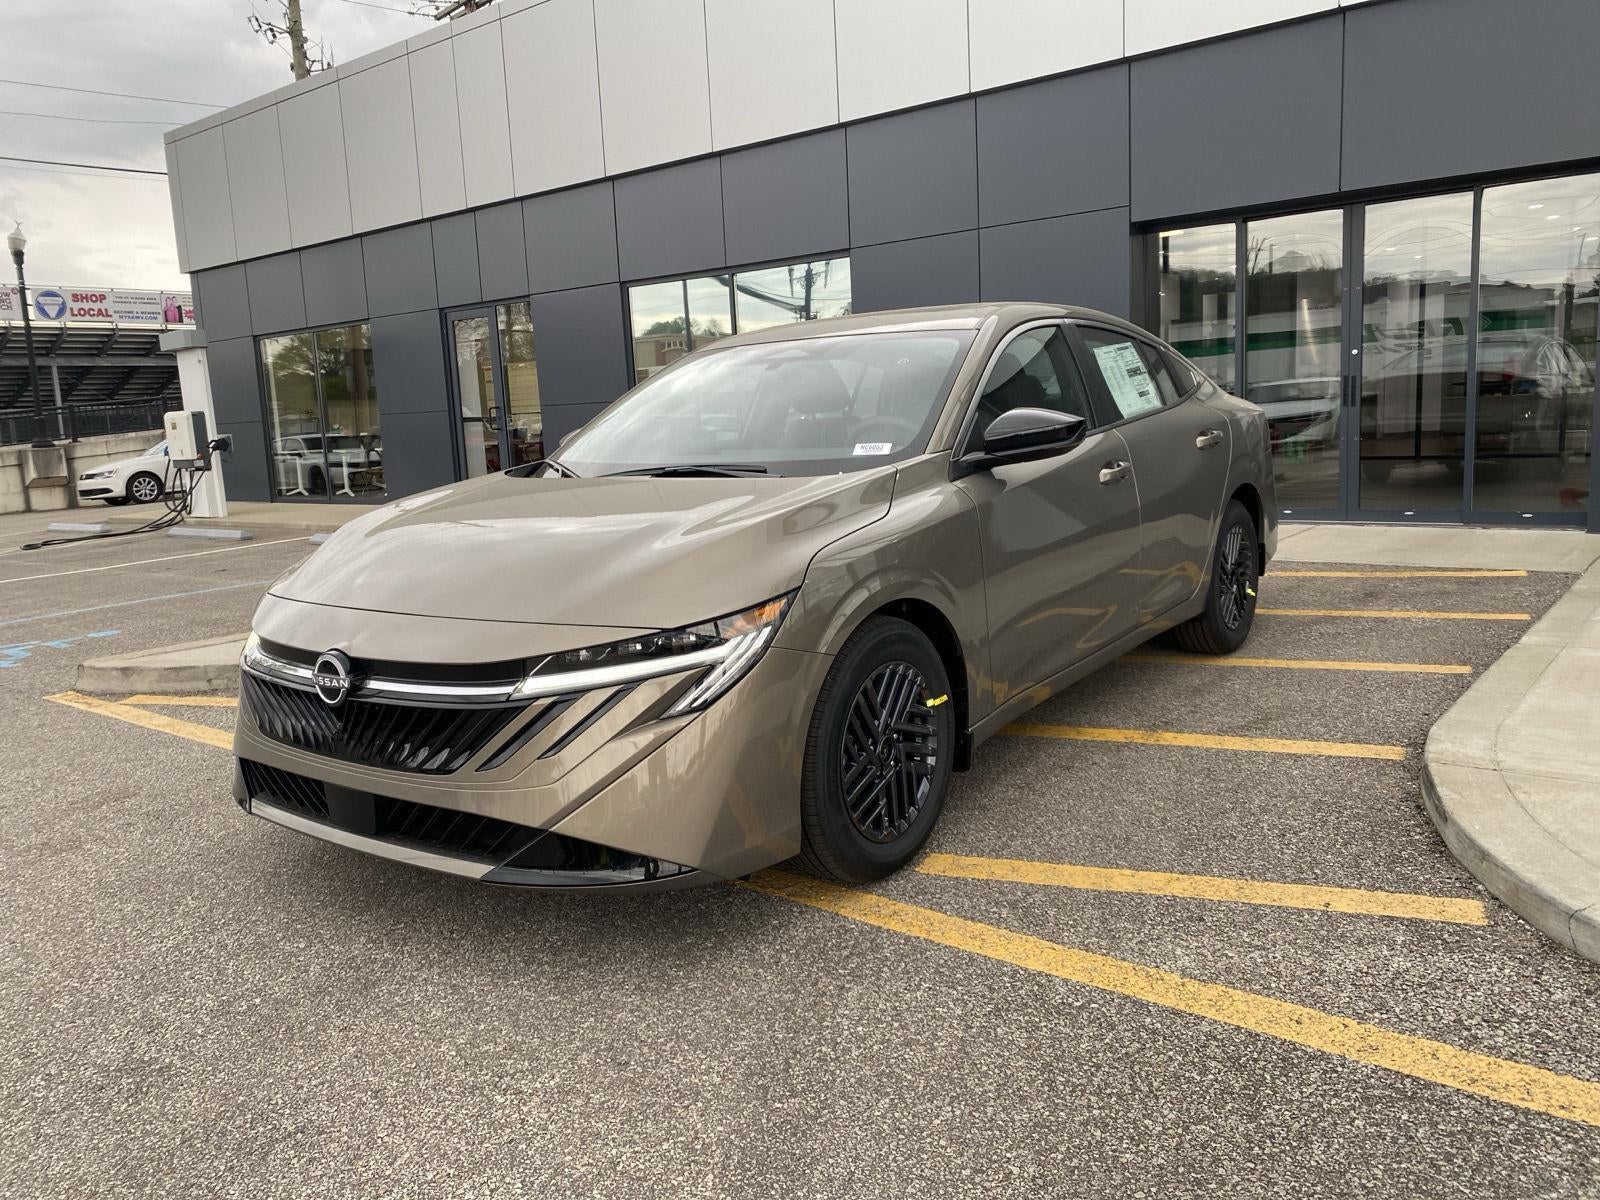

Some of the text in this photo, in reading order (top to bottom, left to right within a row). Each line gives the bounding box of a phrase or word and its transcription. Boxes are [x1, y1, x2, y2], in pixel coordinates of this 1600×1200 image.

[71, 293, 106, 303] SHOP
[70, 307, 112, 317] LOCAL
[312, 676, 348, 688] NISSAN
